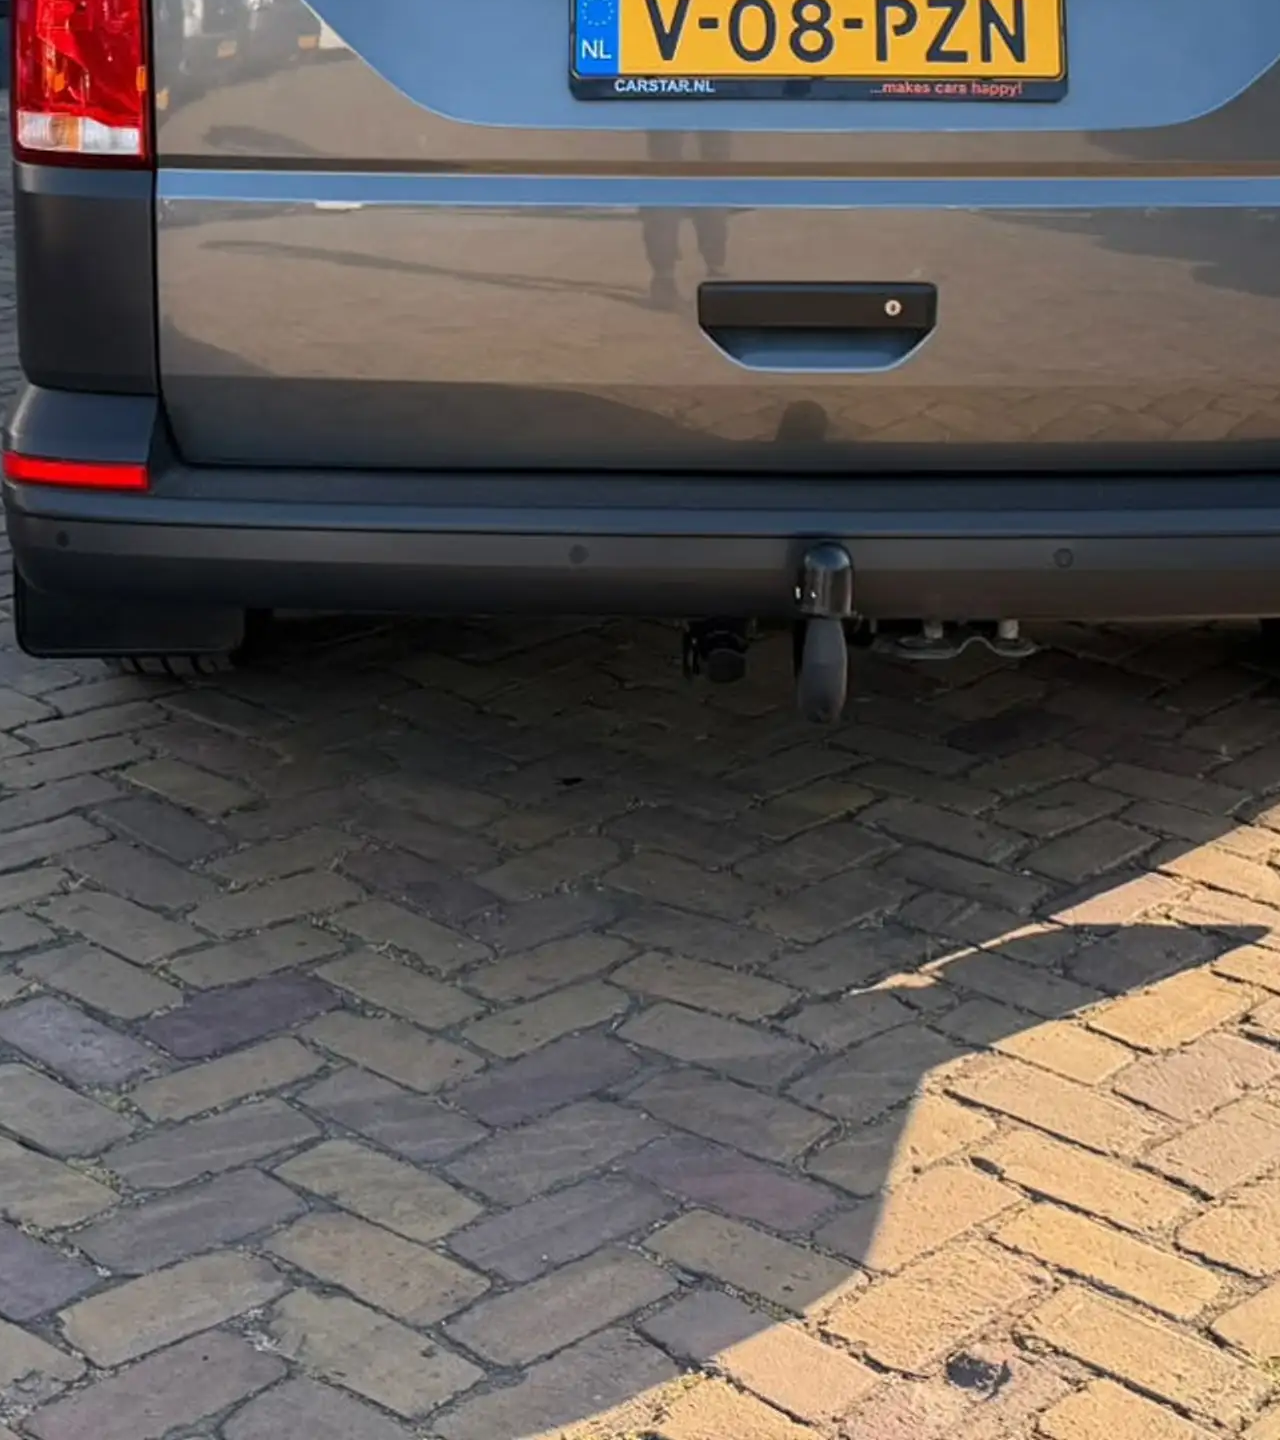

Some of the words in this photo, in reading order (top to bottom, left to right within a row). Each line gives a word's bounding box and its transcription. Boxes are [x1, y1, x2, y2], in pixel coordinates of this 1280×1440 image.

[581, 38, 612, 60] NL
[614, 78, 717, 93] CARSTAR.NL
[934, 82, 967, 95] cars
[971, 81, 1023, 97] happy!
